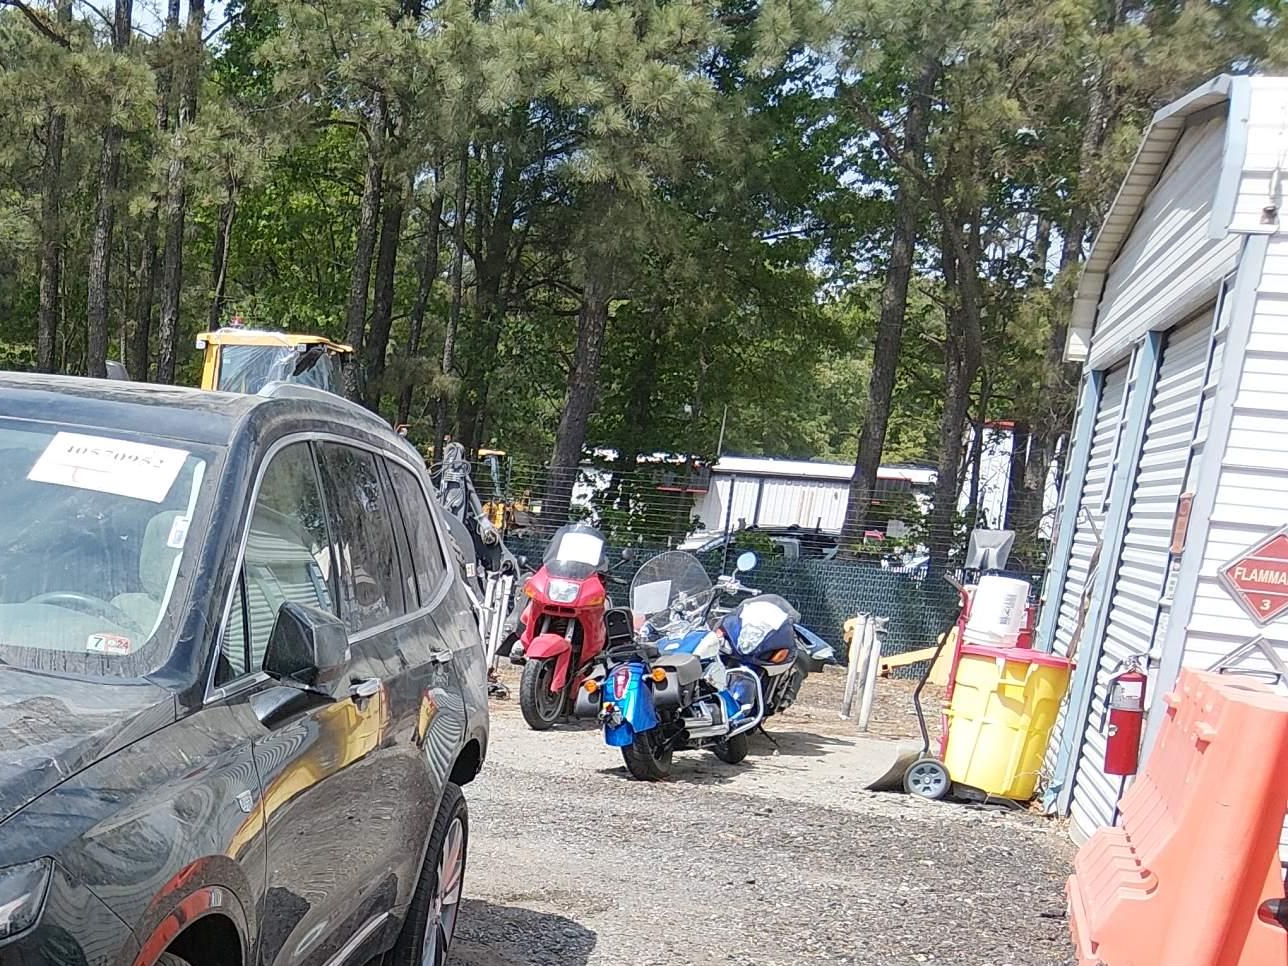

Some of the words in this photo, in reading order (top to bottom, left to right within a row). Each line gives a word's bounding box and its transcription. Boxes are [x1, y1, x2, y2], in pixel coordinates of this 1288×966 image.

[1234, 567, 1288, 586] FLAMMA
[1260, 599, 1272, 611] 3
[93, 637, 103, 648] 7
